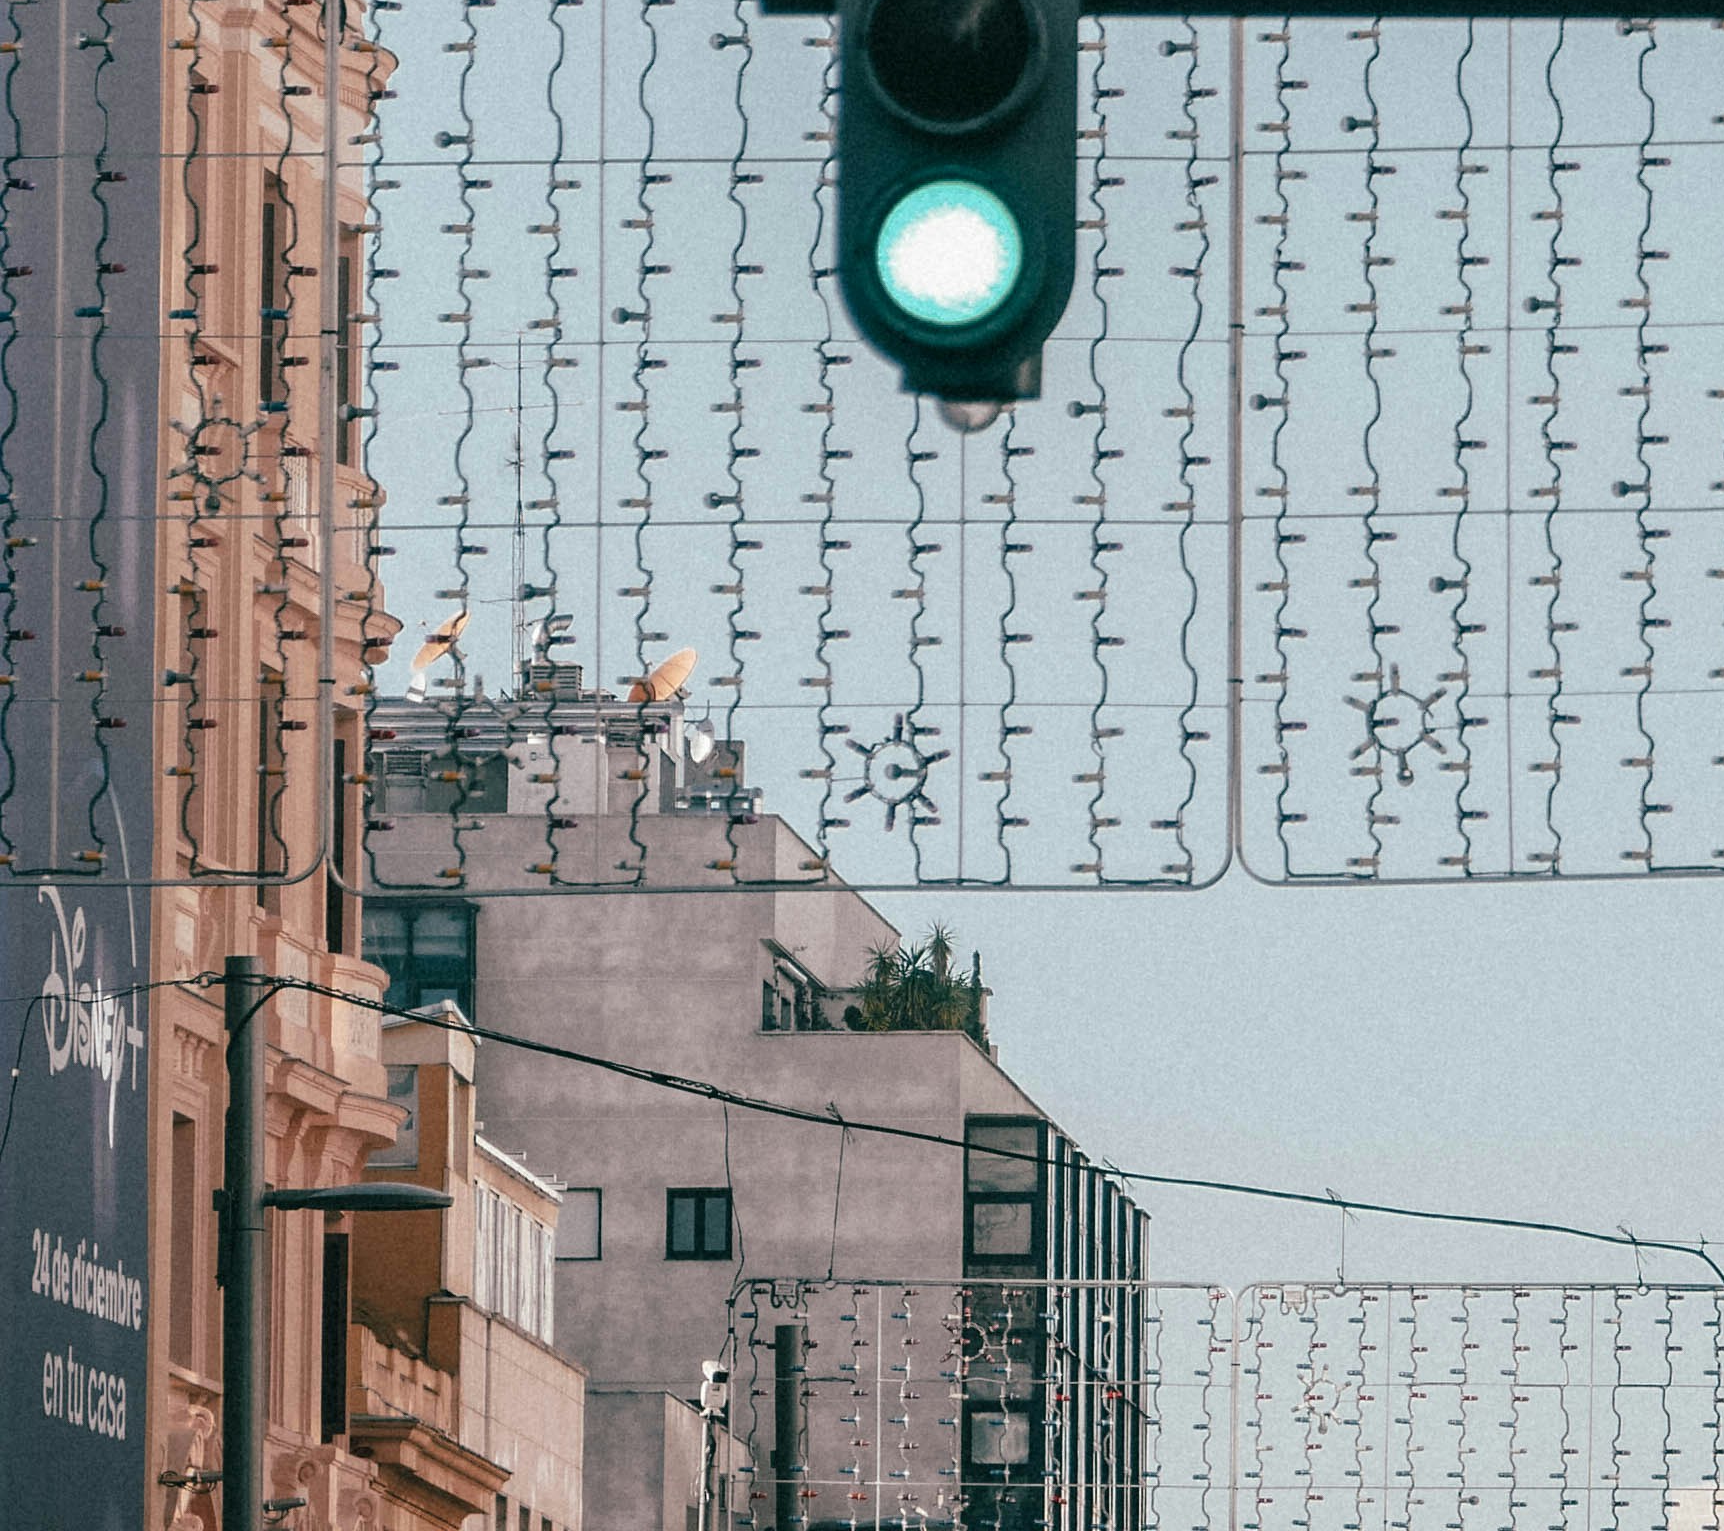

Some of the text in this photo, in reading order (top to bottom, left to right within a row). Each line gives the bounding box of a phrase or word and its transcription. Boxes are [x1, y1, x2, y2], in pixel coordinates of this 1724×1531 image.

[32, 1228, 143, 1331] 24 de diciembre
[43, 1344, 126, 1440] en tu casa
